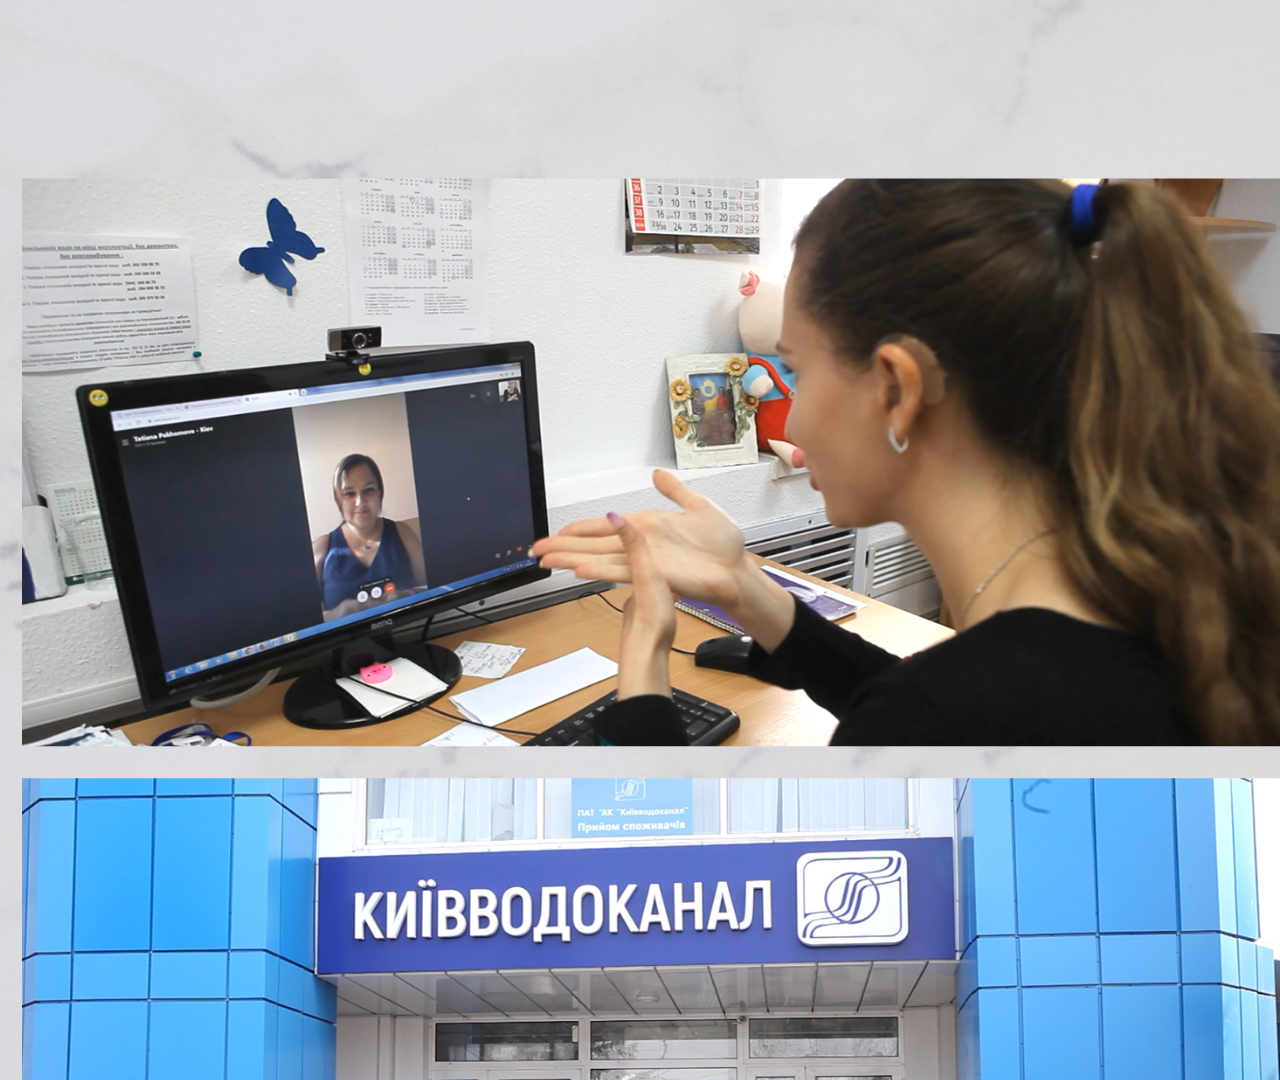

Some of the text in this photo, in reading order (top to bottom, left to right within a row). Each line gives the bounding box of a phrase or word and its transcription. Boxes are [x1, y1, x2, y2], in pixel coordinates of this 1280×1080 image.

[658, 186, 662, 194] 2
[675, 187, 679, 195] 3
[691, 188, 695, 196] 4
[708, 189, 712, 197] 5
[723, 190, 727, 198] 6
[754, 192, 759, 200] 8
[658, 198, 663, 207] 9
[671, 199, 679, 207] 10
[689, 200, 696, 208] 11
[705, 201, 712, 209] 12
[721, 202, 727, 210] 13
[735, 202, 743, 211] 14
[751, 203, 759, 211] 15
[657, 210, 665, 219] 16
[673, 211, 681, 219] 17
[688, 212, 696, 220] 18
[705, 213, 712, 221] 19
[719, 213, 728, 221] 20
[735, 214, 743, 222] 21
[751, 215, 759, 223] 22
[674, 223, 682, 231] 24
[690, 224, 698, 232] 25
[705, 225, 713, 233] 26
[721, 225, 728, 233] 27
[735, 226, 743, 234] 28
[133, 434, 158, 442] Tatiana
[577, 809, 595, 817] ПАТ
[577, 820, 686, 833] Прийом споживачів
[354, 878, 772, 943] КИЇВВОДОКАНАЛ
